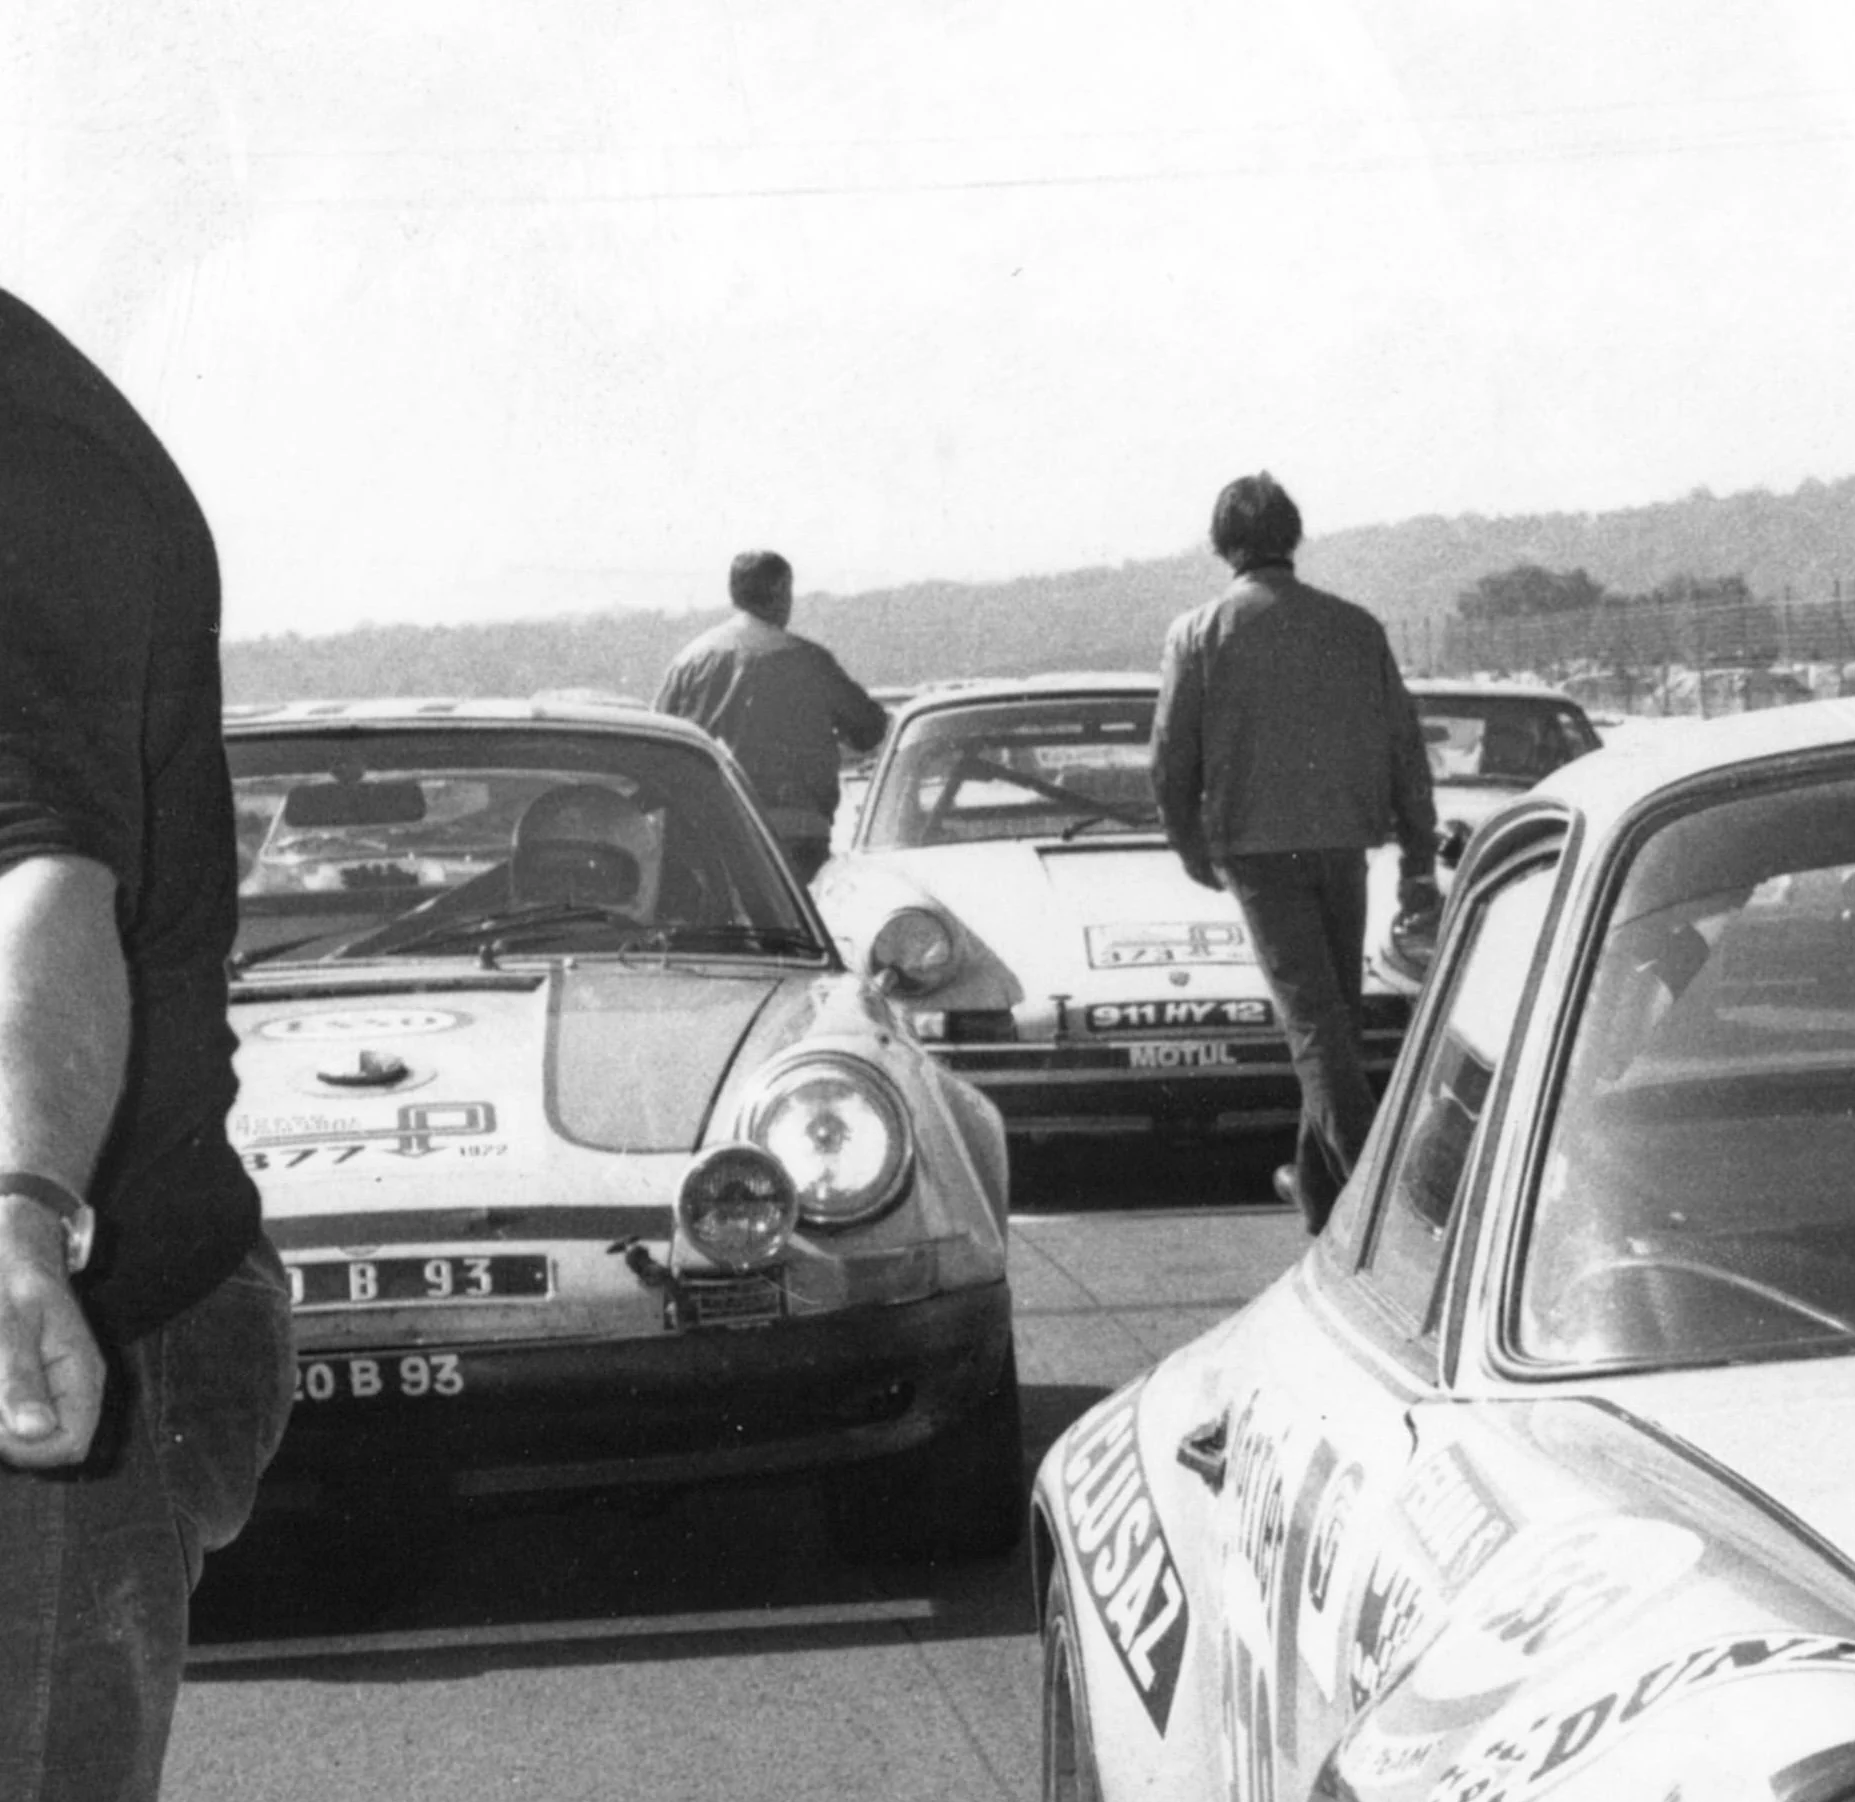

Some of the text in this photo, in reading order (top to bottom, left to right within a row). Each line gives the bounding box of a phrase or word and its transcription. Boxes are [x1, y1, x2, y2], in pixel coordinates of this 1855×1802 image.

[1093, 1001, 1267, 1027] 911 HY 12
[1129, 1043, 1238, 1068] MOTUL
[349, 1262, 378, 1301] B
[423, 1257, 493, 1297] 93
[350, 1358, 383, 1398] B
[400, 1353, 465, 1396] 93
[1064, 1403, 1185, 1693] CLUSAZ
